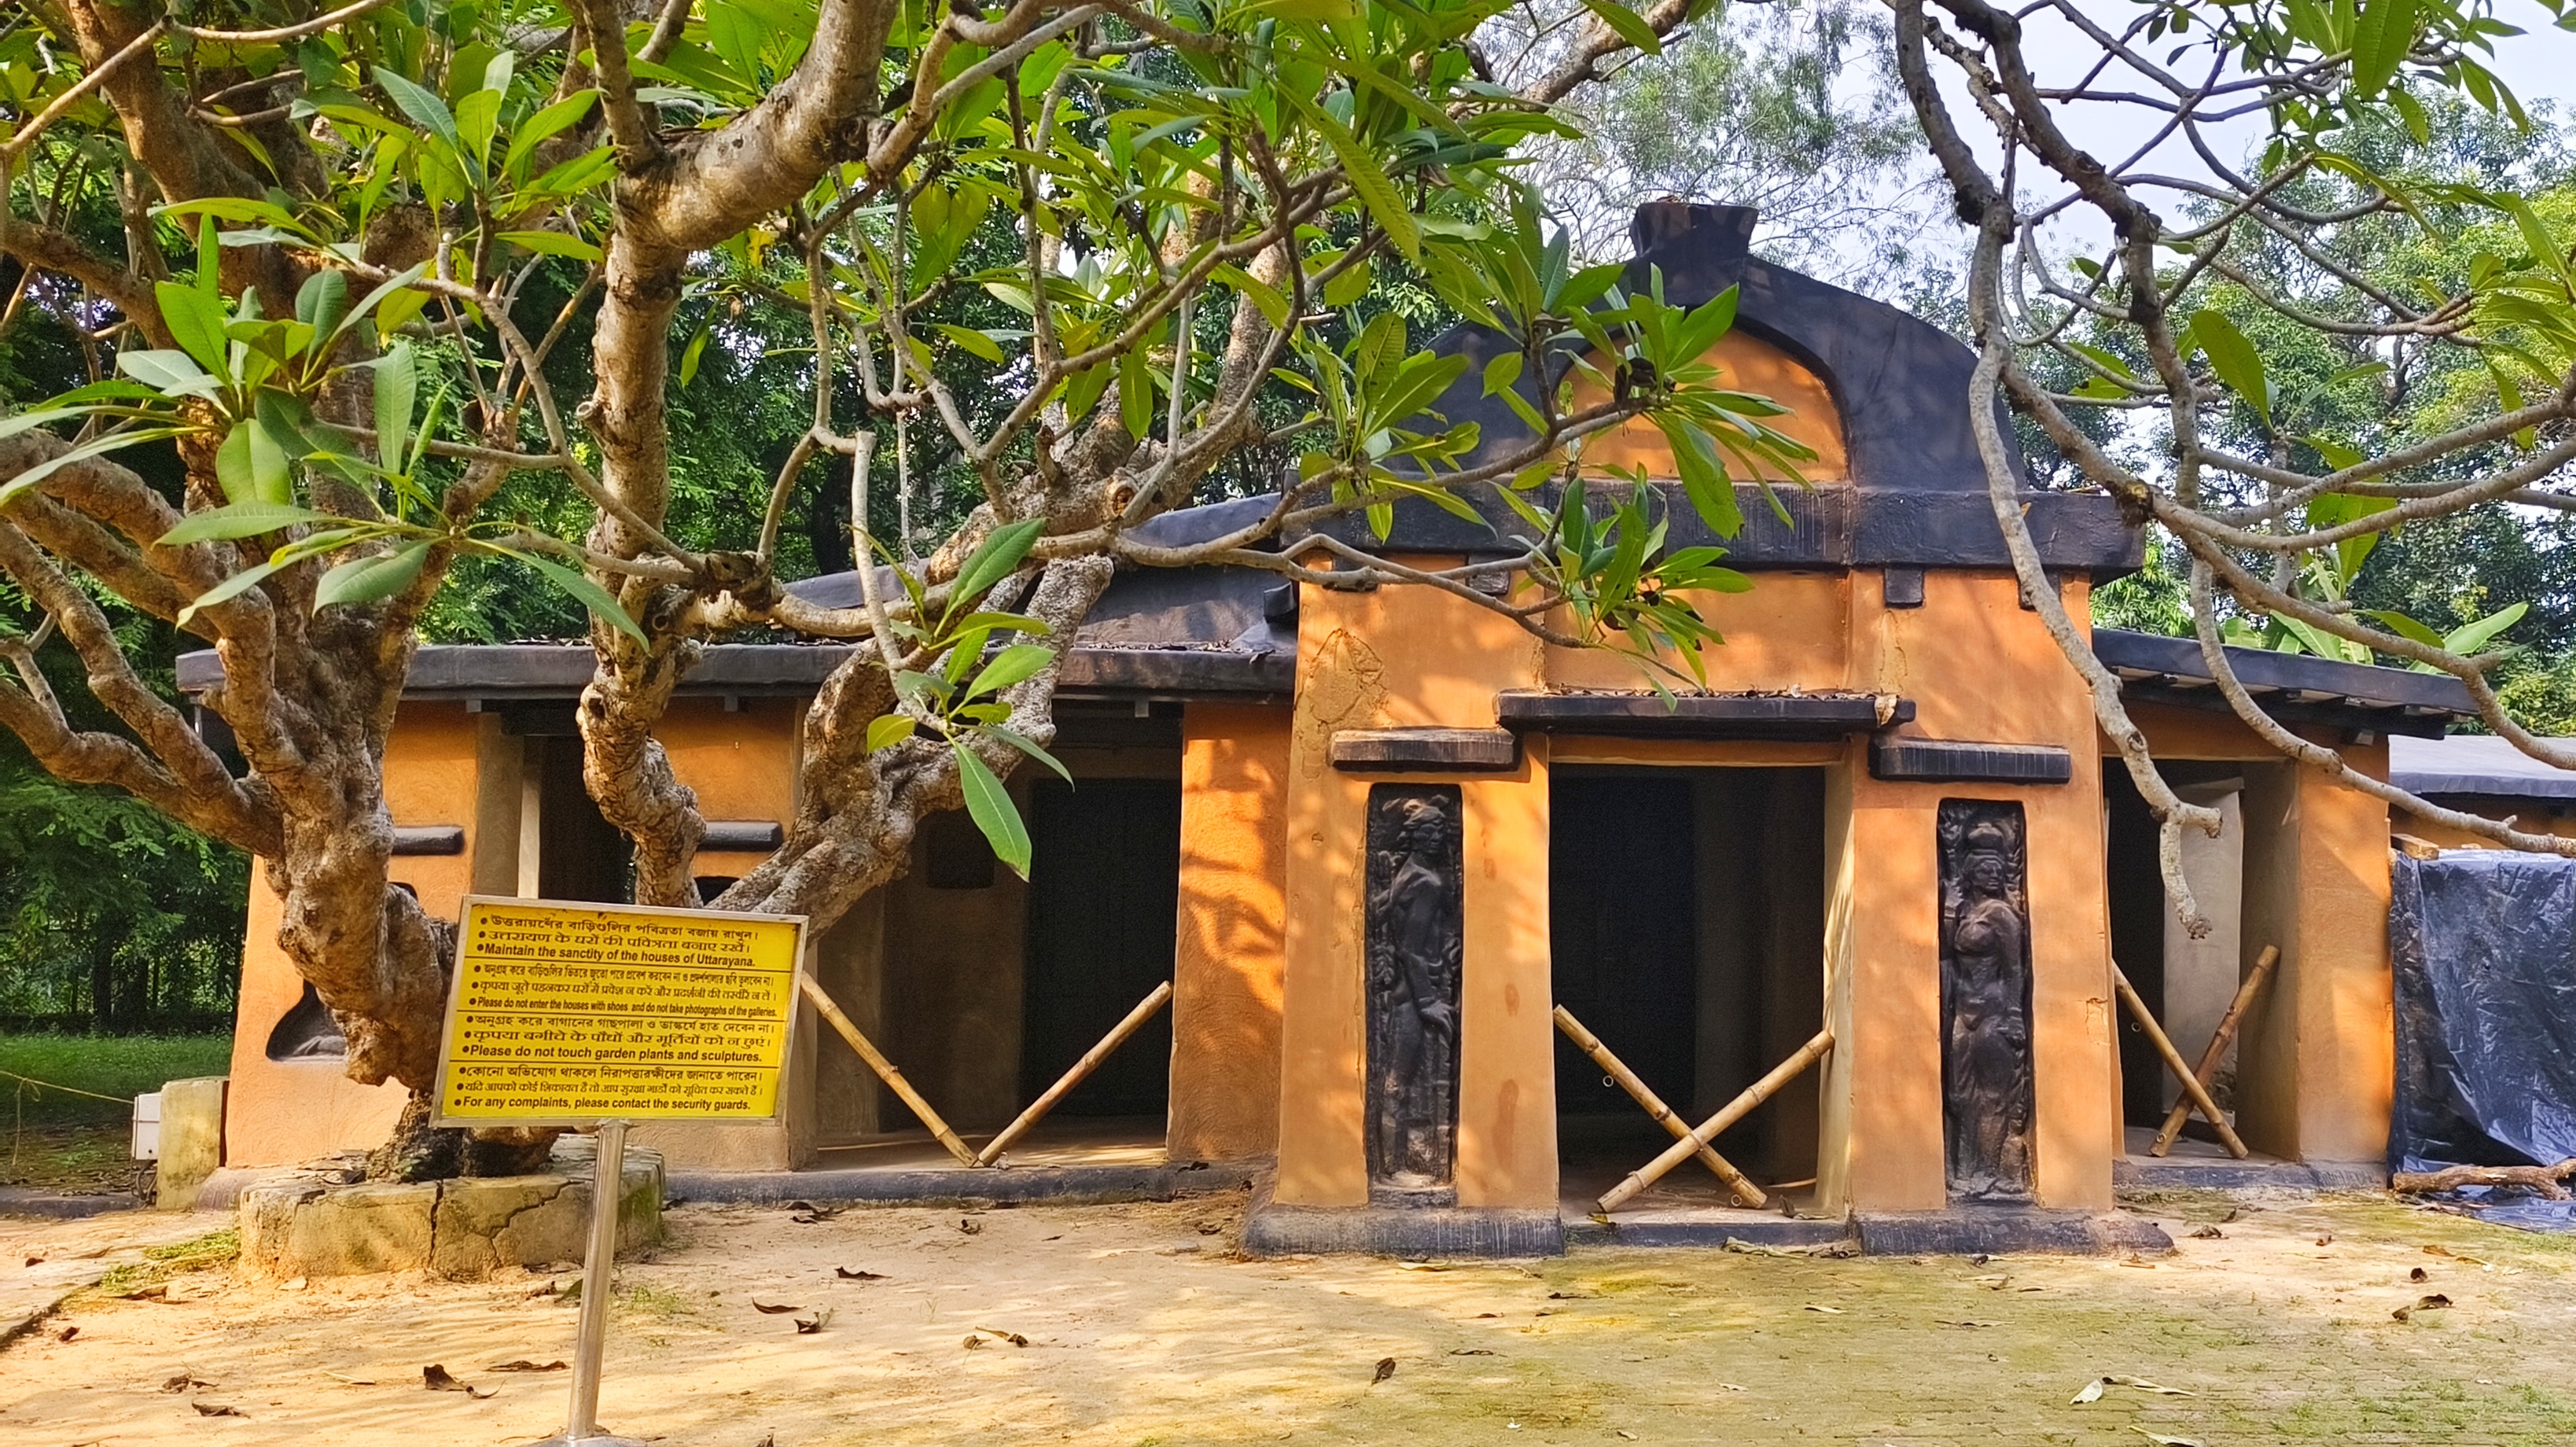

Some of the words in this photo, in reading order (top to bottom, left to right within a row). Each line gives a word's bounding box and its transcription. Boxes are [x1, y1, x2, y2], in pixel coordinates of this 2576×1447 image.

[567, 919, 631, 933] বাড়িগুলির
[635, 922, 683, 935] পবিত্রতা
[686, 927, 718, 937] বজায়
[554, 931, 571, 943] के
[574, 933, 599, 944] घरों
[602, 934, 623, 945] की
[627, 936, 678, 948] पवित्रता
[681, 941, 717, 952] बनाए
[484, 942, 535, 955] Maintain
[537, 945, 556, 957] the
[558, 948, 604, 960] sanctity
[606, 948, 619, 959] of
[620, 949, 638, 961] the
[640, 950, 680, 963] houses
[683, 952, 695, 963] of
[697, 953, 755, 967] Uttarayana.
[484, 964, 508, 977] অনুগ্রহ
[509, 965, 525, 975] করে
[527, 963, 563, 978] বাড়িগুলির
[609, 970, 624, 979] পরে
[626, 970, 646, 980] প্রবেশ
[647, 971, 672, 981] করবেন
[672, 972, 680, 981] না
[683, 973, 688, 981] ও
[480, 981, 509, 992] कृपया
[511, 979, 530, 994] जूते
[531, 982, 571, 992] पहनकर
[602, 982, 624, 995] प्रवेश
[625, 986, 635, 995] न
[636, 984, 653, 995] करें
[653, 985, 672, 996] और
[672, 985, 705, 998] प्रदर्शनी
[707, 987, 721, 998] की
[477, 996, 502, 1007] Please
[503, 997, 513, 1007] do
[514, 998, 528, 1008] not
[528, 999, 549, 1008] enter
[549, 999, 561, 1009] the
[562, 999, 589, 1010] houses
[591, 1000, 605, 1011] with
[606, 1000, 627, 1011] shoes
[631, 1002, 645, 1011] and
[646, 1002, 655, 1012] do
[656, 1003, 668, 1012] not
[668, 1003, 683, 1013] take
[684, 1003, 727, 1016] photographs
[727, 1005, 735, 1014] of
[736, 1006, 747, 1015] the
[748, 1006, 776, 1018] galleries.
[474, 1015, 514, 1027] অনুগ্রহ
[516, 1016, 543, 1025] করে
[545, 1017, 593, 1027] বাগানের
[597, 1018, 643, 1029] গাছপালা
[699, 1022, 719, 1032] হাত
[723, 1023, 755, 1032] দেবেন
[473, 1030, 520, 1043] कृपया
[523, 1029, 567, 1040] बगीचे
[569, 1029, 587, 1041] के
[591, 1030, 623, 1042] पौधों
[626, 1032, 653, 1043] और
[656, 1033, 700, 1047] मूर्तियों
[704, 1034, 724, 1044] को
[469, 1044, 511, 1056] Please
[514, 1045, 531, 1056] do
[534, 1047, 554, 1057] not
[558, 1047, 591, 1058] touch
[594, 1047, 635, 1059] garden
[638, 1048, 674, 1060] plants
[676, 1049, 698, 1060] and
[701, 1050, 761, 1062] sculptures.
[466, 1066, 503, 1077] কোনো
[506, 1063, 557, 1077] অভিযোগ
[560, 1067, 597, 1077] থাকলে
[599, 1065, 683, 1079] নিরাপত্তারক্ষীদের
[686, 1070, 724, 1080] জানাতে
[465, 1080, 484, 1091] यदि
[484, 1081, 517, 1091] आपको
[518, 1081, 538, 1092] कोई
[539, 1081, 579, 1092] शिकायत
[580, 1081, 587, 1092] है
[588, 1081, 599, 1092] तो
[620, 1084, 645, 1095] सुरक्षा
[668, 1083, 681, 1093] को
[683, 1083, 708, 1096] सूचित
[725, 1084, 749, 1095] सकते
[462, 1095, 483, 1106] For
[484, 1098, 506, 1109] any
[508, 1096, 571, 1109] complaints,
[574, 1097, 609, 1109] please
[611, 1098, 650, 1108] contact
[653, 1098, 669, 1108] the
[671, 1099, 712, 1111] security
[713, 1099, 750, 1111] guards.
